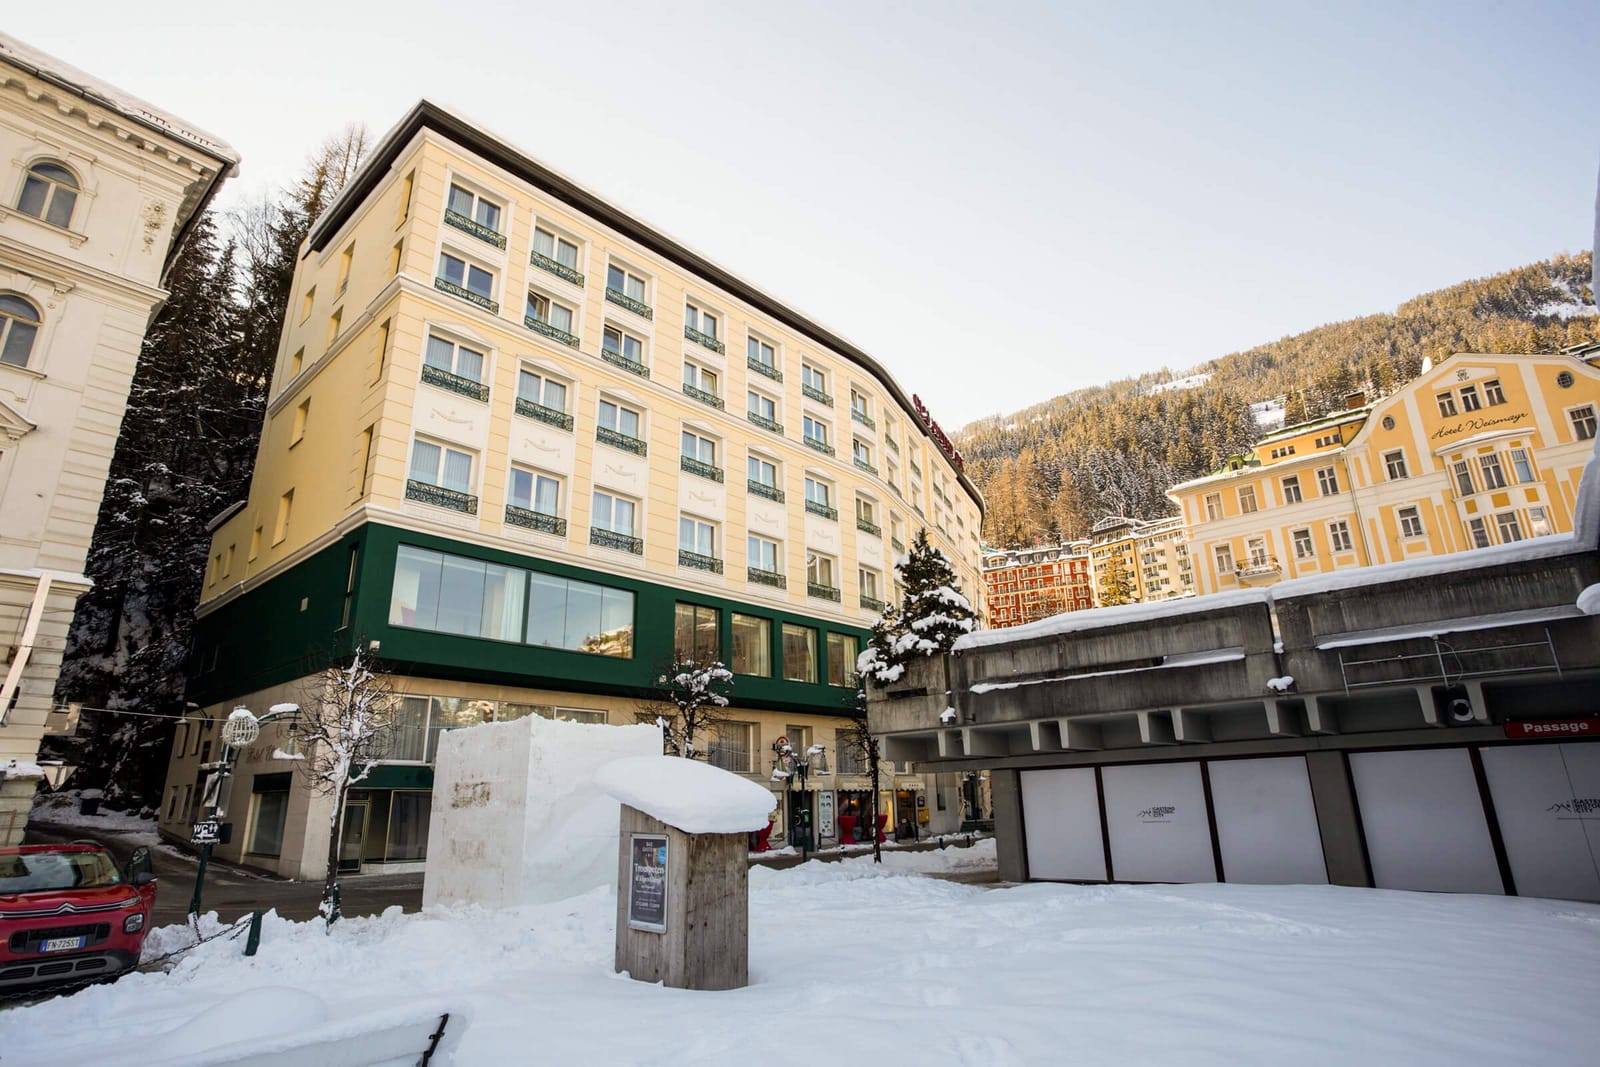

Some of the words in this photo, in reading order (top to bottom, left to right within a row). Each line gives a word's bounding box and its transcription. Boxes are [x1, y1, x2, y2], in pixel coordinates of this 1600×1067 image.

[1431, 424, 1464, 439] Hotel
[1466, 412, 1528, 430] Weismayr
[1523, 722, 1589, 733] Passage
[193, 824, 209, 833] WC
